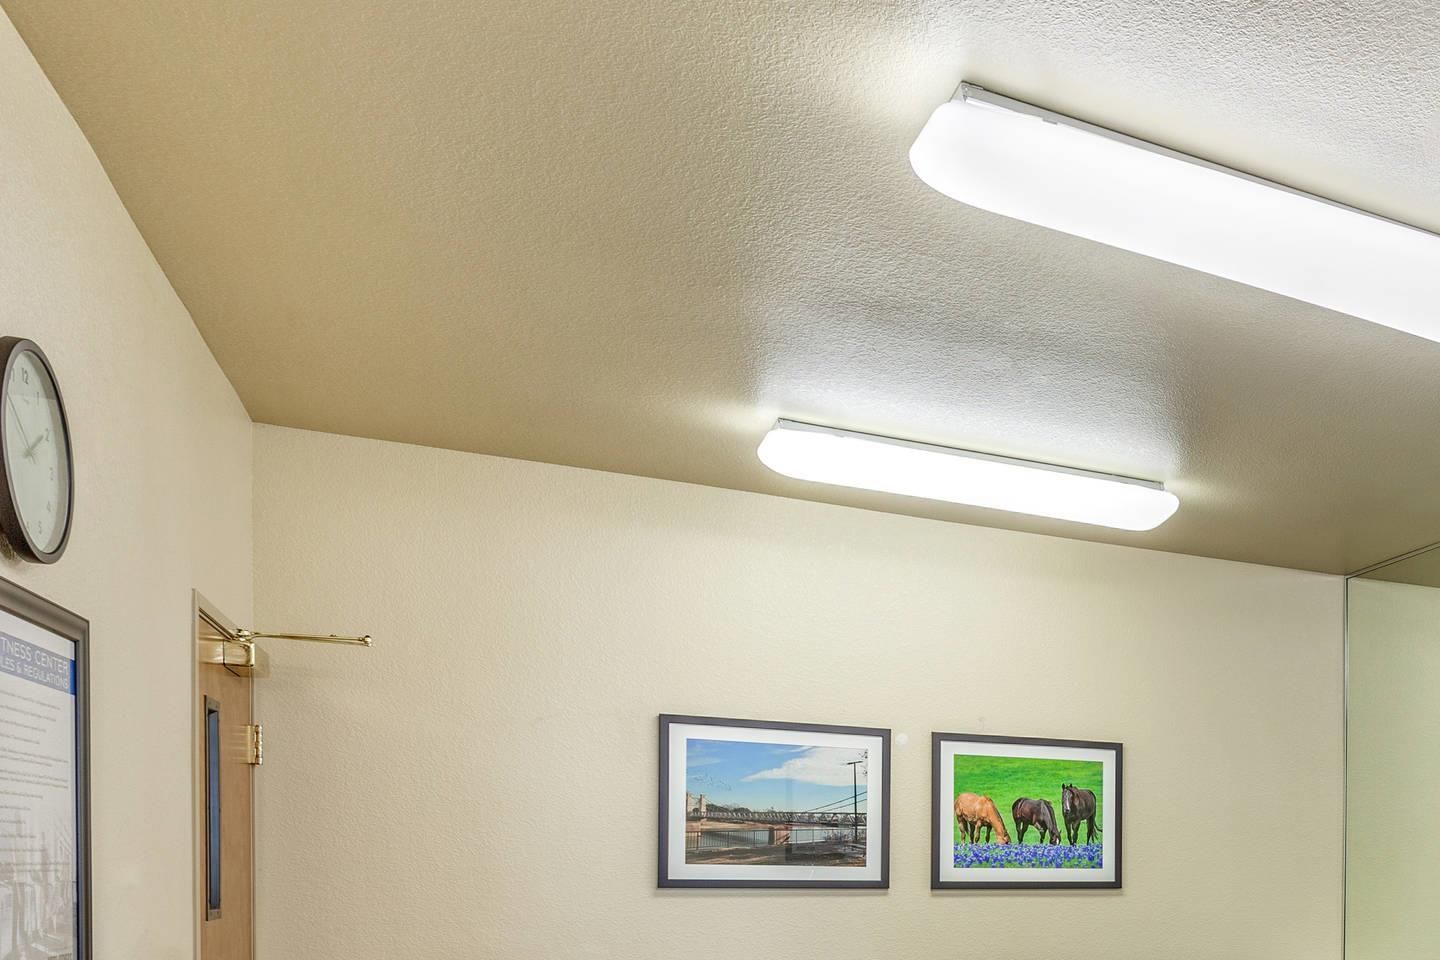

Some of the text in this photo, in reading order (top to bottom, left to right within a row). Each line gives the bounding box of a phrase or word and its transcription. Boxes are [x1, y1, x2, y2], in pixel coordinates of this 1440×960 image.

[21, 368, 29, 384] 12
[34, 650, 68, 674] CENTER
[23, 664, 69, 688] REGULATIONS
